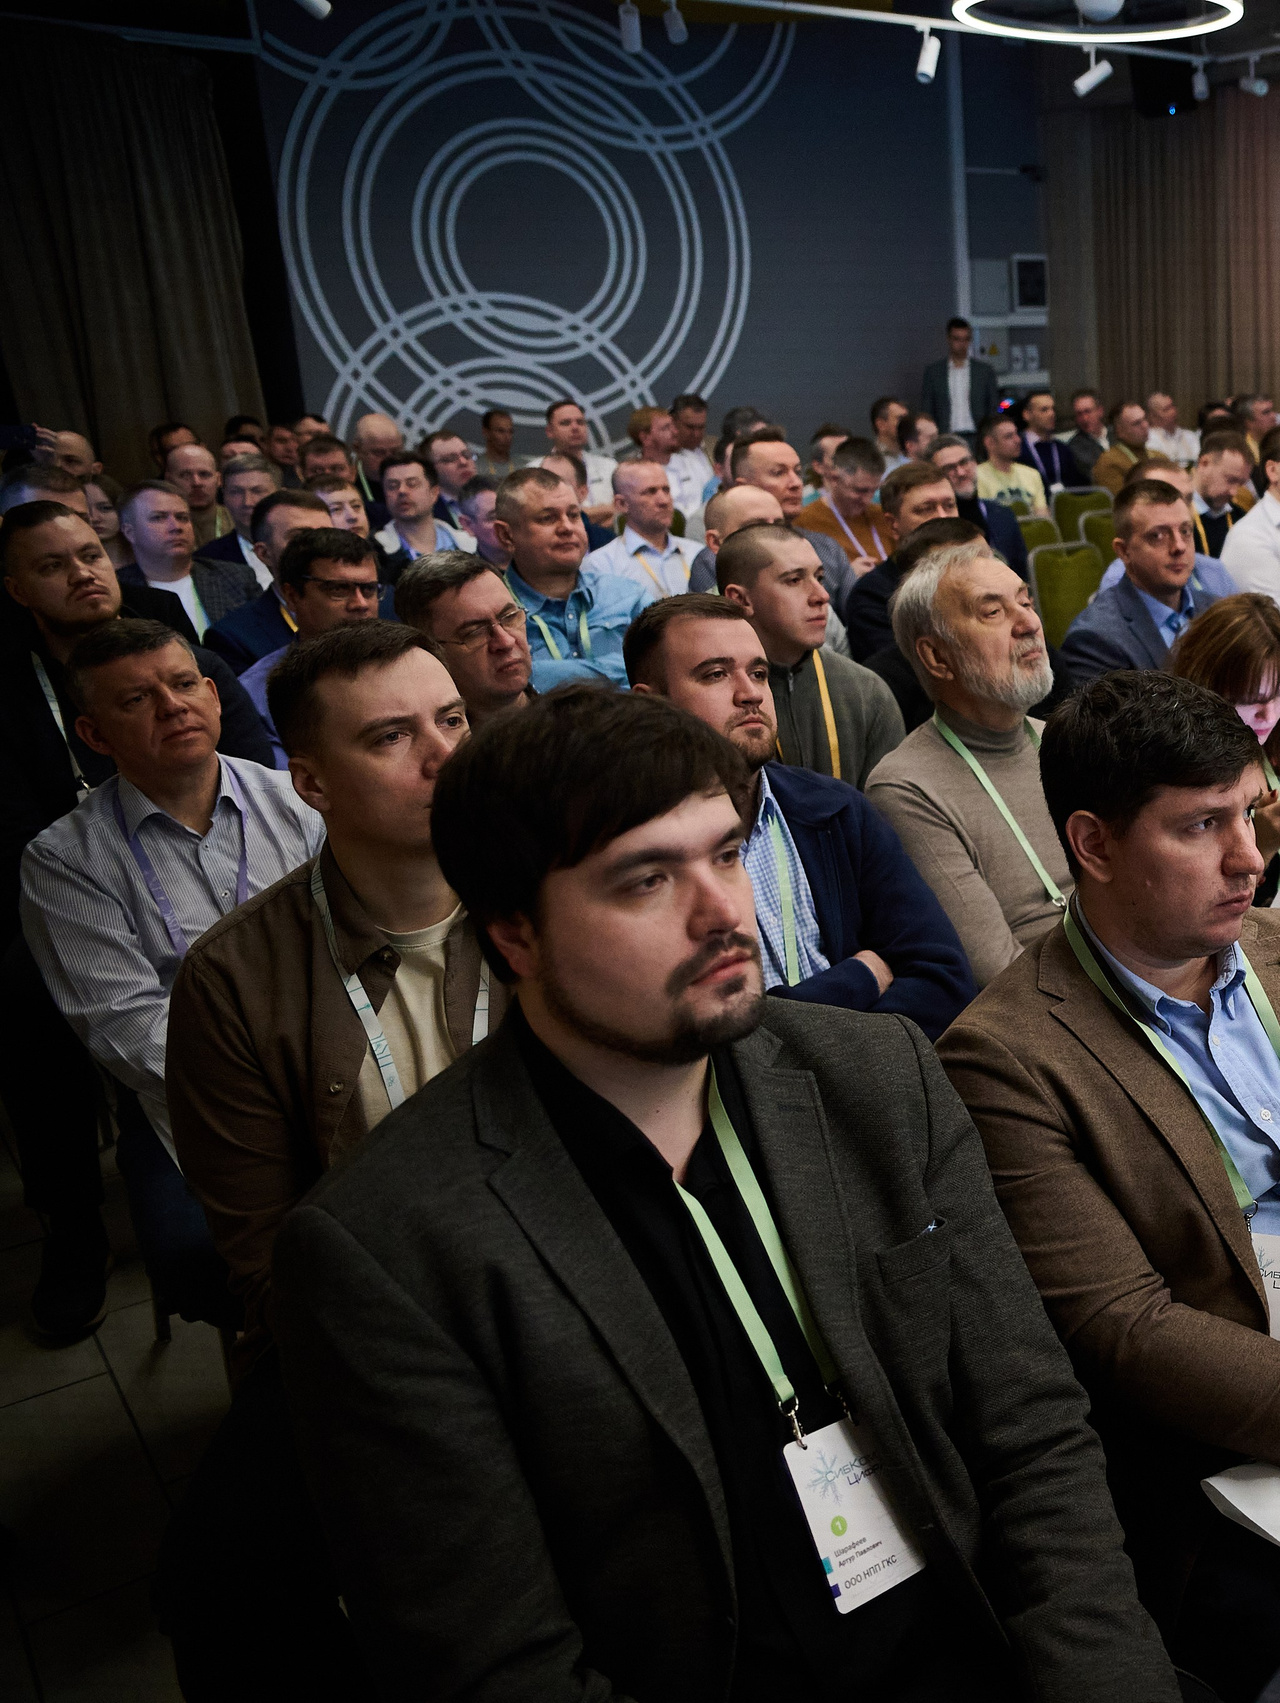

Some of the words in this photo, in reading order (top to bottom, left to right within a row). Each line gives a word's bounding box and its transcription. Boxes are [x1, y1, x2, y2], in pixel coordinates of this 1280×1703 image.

[838, 1555, 856, 1568] Артур
[855, 1540, 882, 1558] Павлович
[844, 1573, 863, 1589] ООО
[863, 1564, 882, 1579] НПП
[881, 1554, 897, 1569] ГКС
